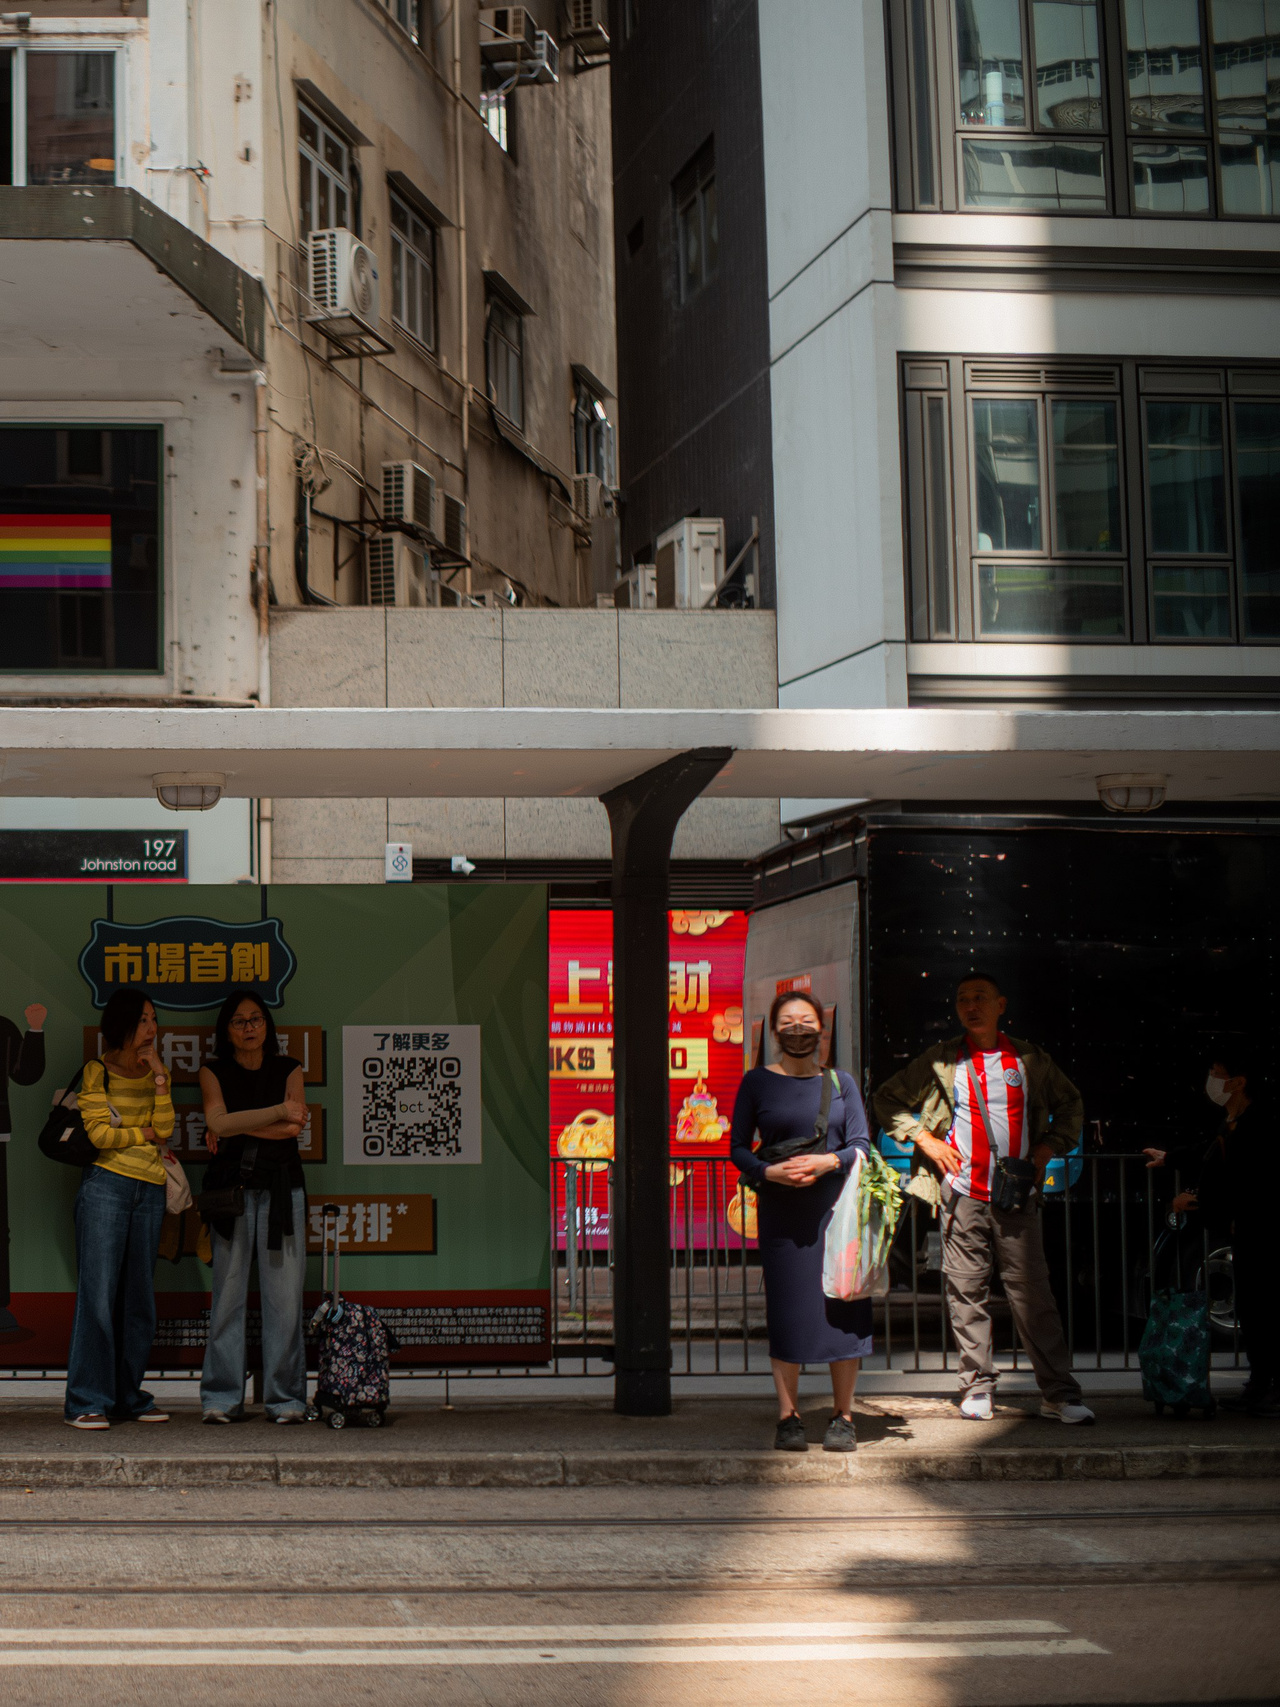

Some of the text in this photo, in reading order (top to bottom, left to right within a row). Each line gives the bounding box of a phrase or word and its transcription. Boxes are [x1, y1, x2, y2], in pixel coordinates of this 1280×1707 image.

[143, 839, 177, 857] 197
[80, 858, 177, 871] Johnston road
[104, 941, 271, 984] 市場首創
[373, 1032, 450, 1051] 了解更多
[399, 1100, 425, 1114] bct
